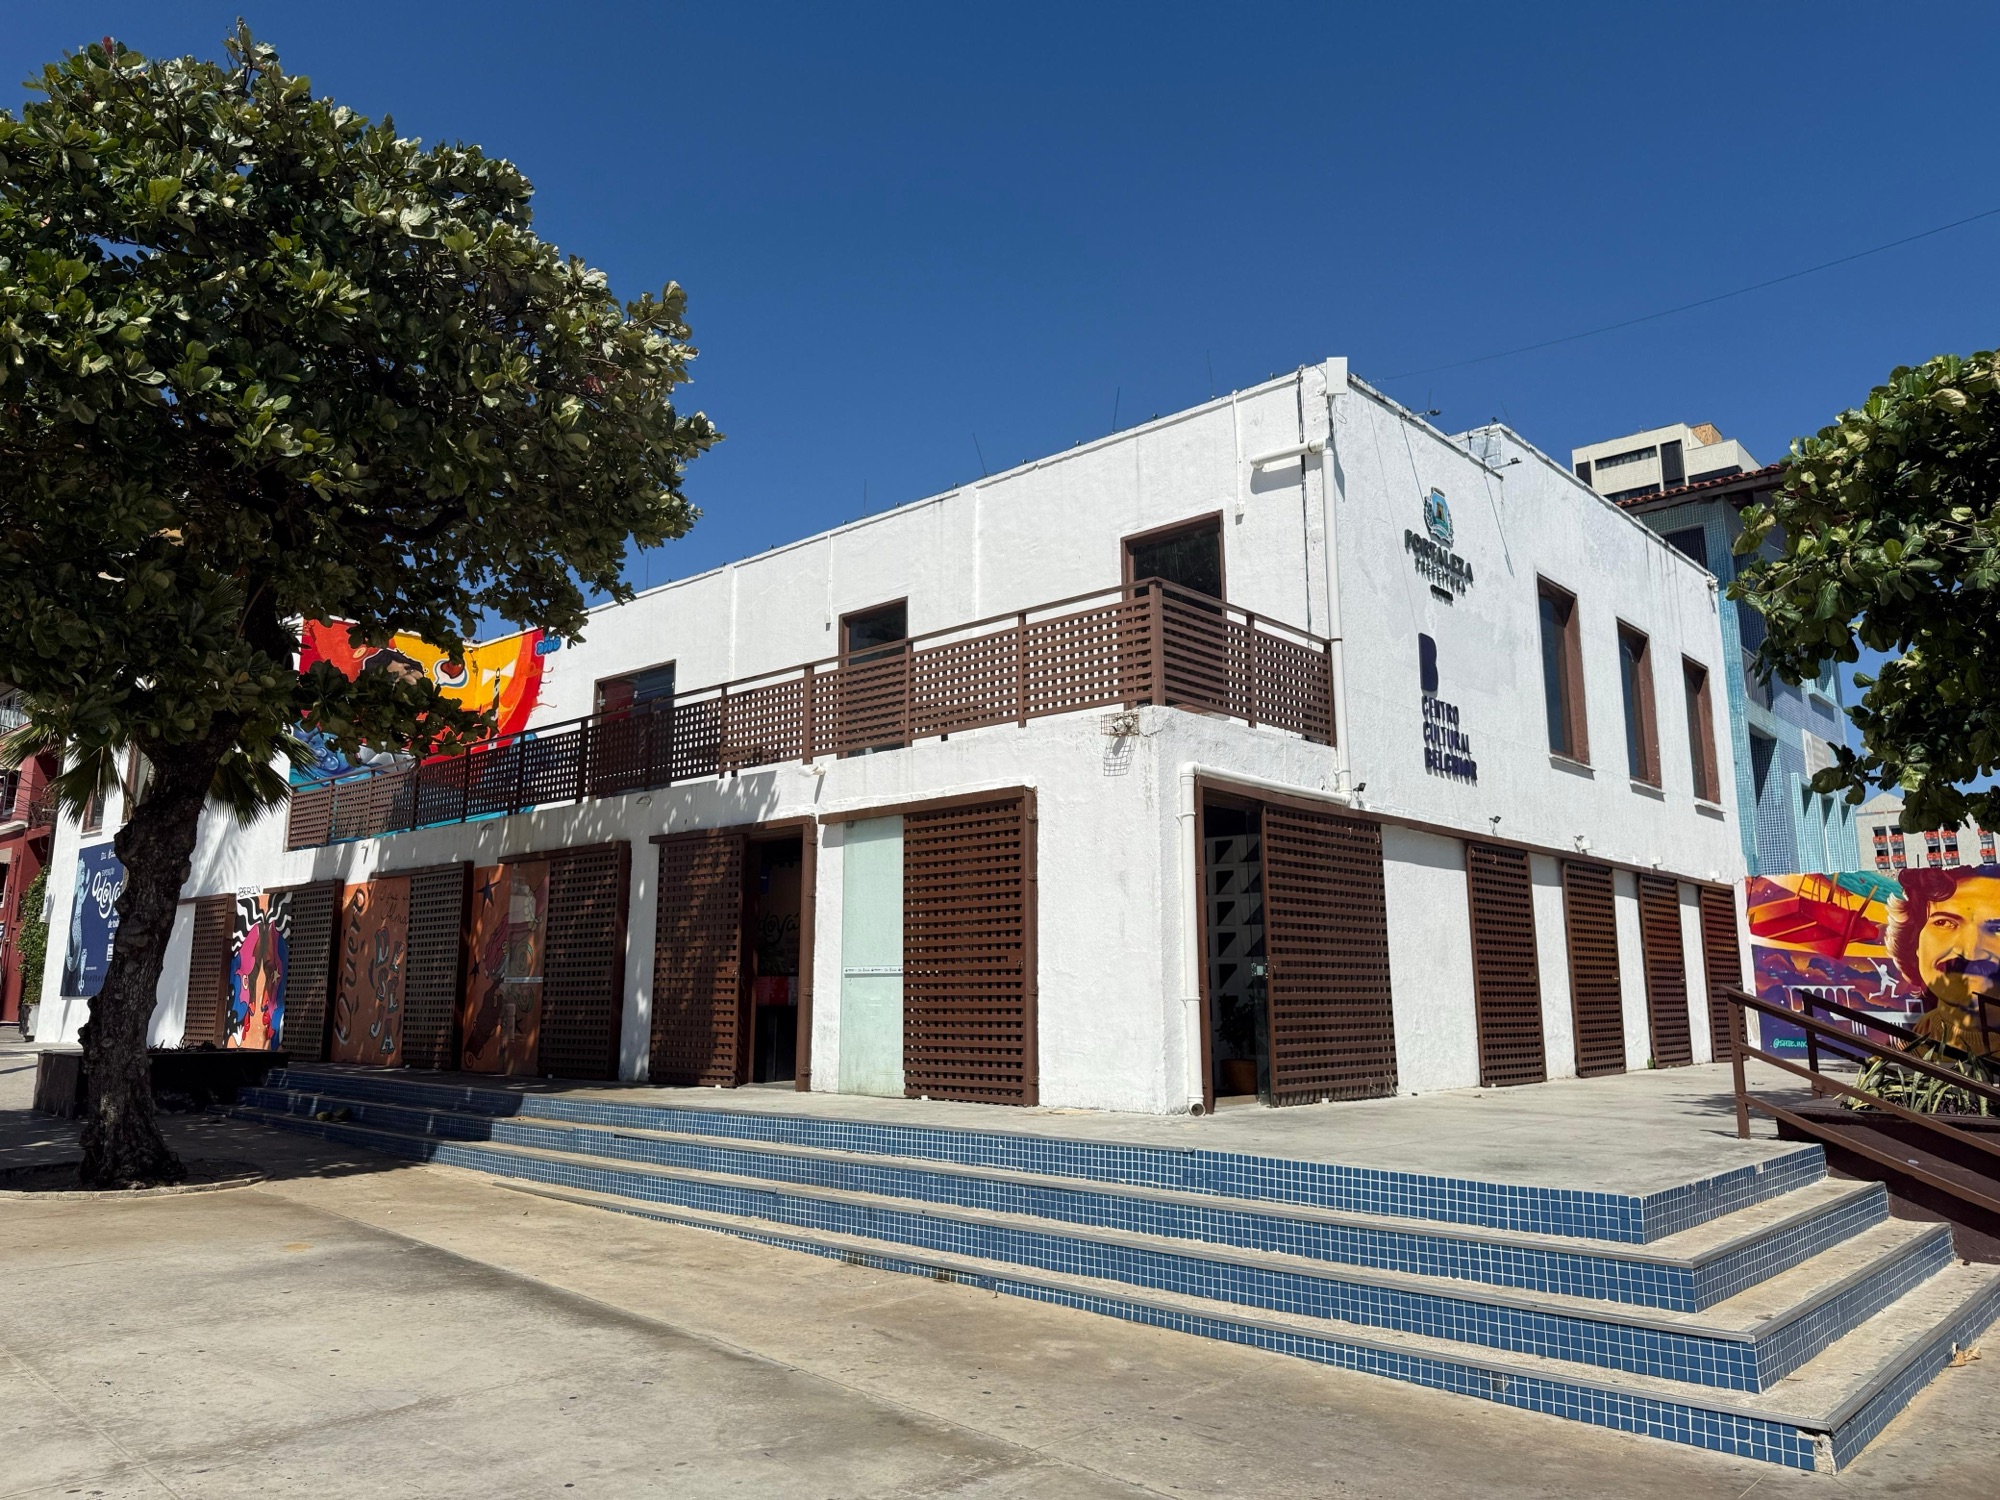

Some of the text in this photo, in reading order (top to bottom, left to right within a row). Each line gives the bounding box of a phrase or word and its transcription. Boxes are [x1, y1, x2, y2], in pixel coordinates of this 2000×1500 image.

[1404, 529, 1474, 582] FORTALEZA
[1422, 695, 1460, 725] CENTRO
[1423, 721, 1472, 754] CULTURAL
[1424, 747, 1478, 781] BELCHIOR
